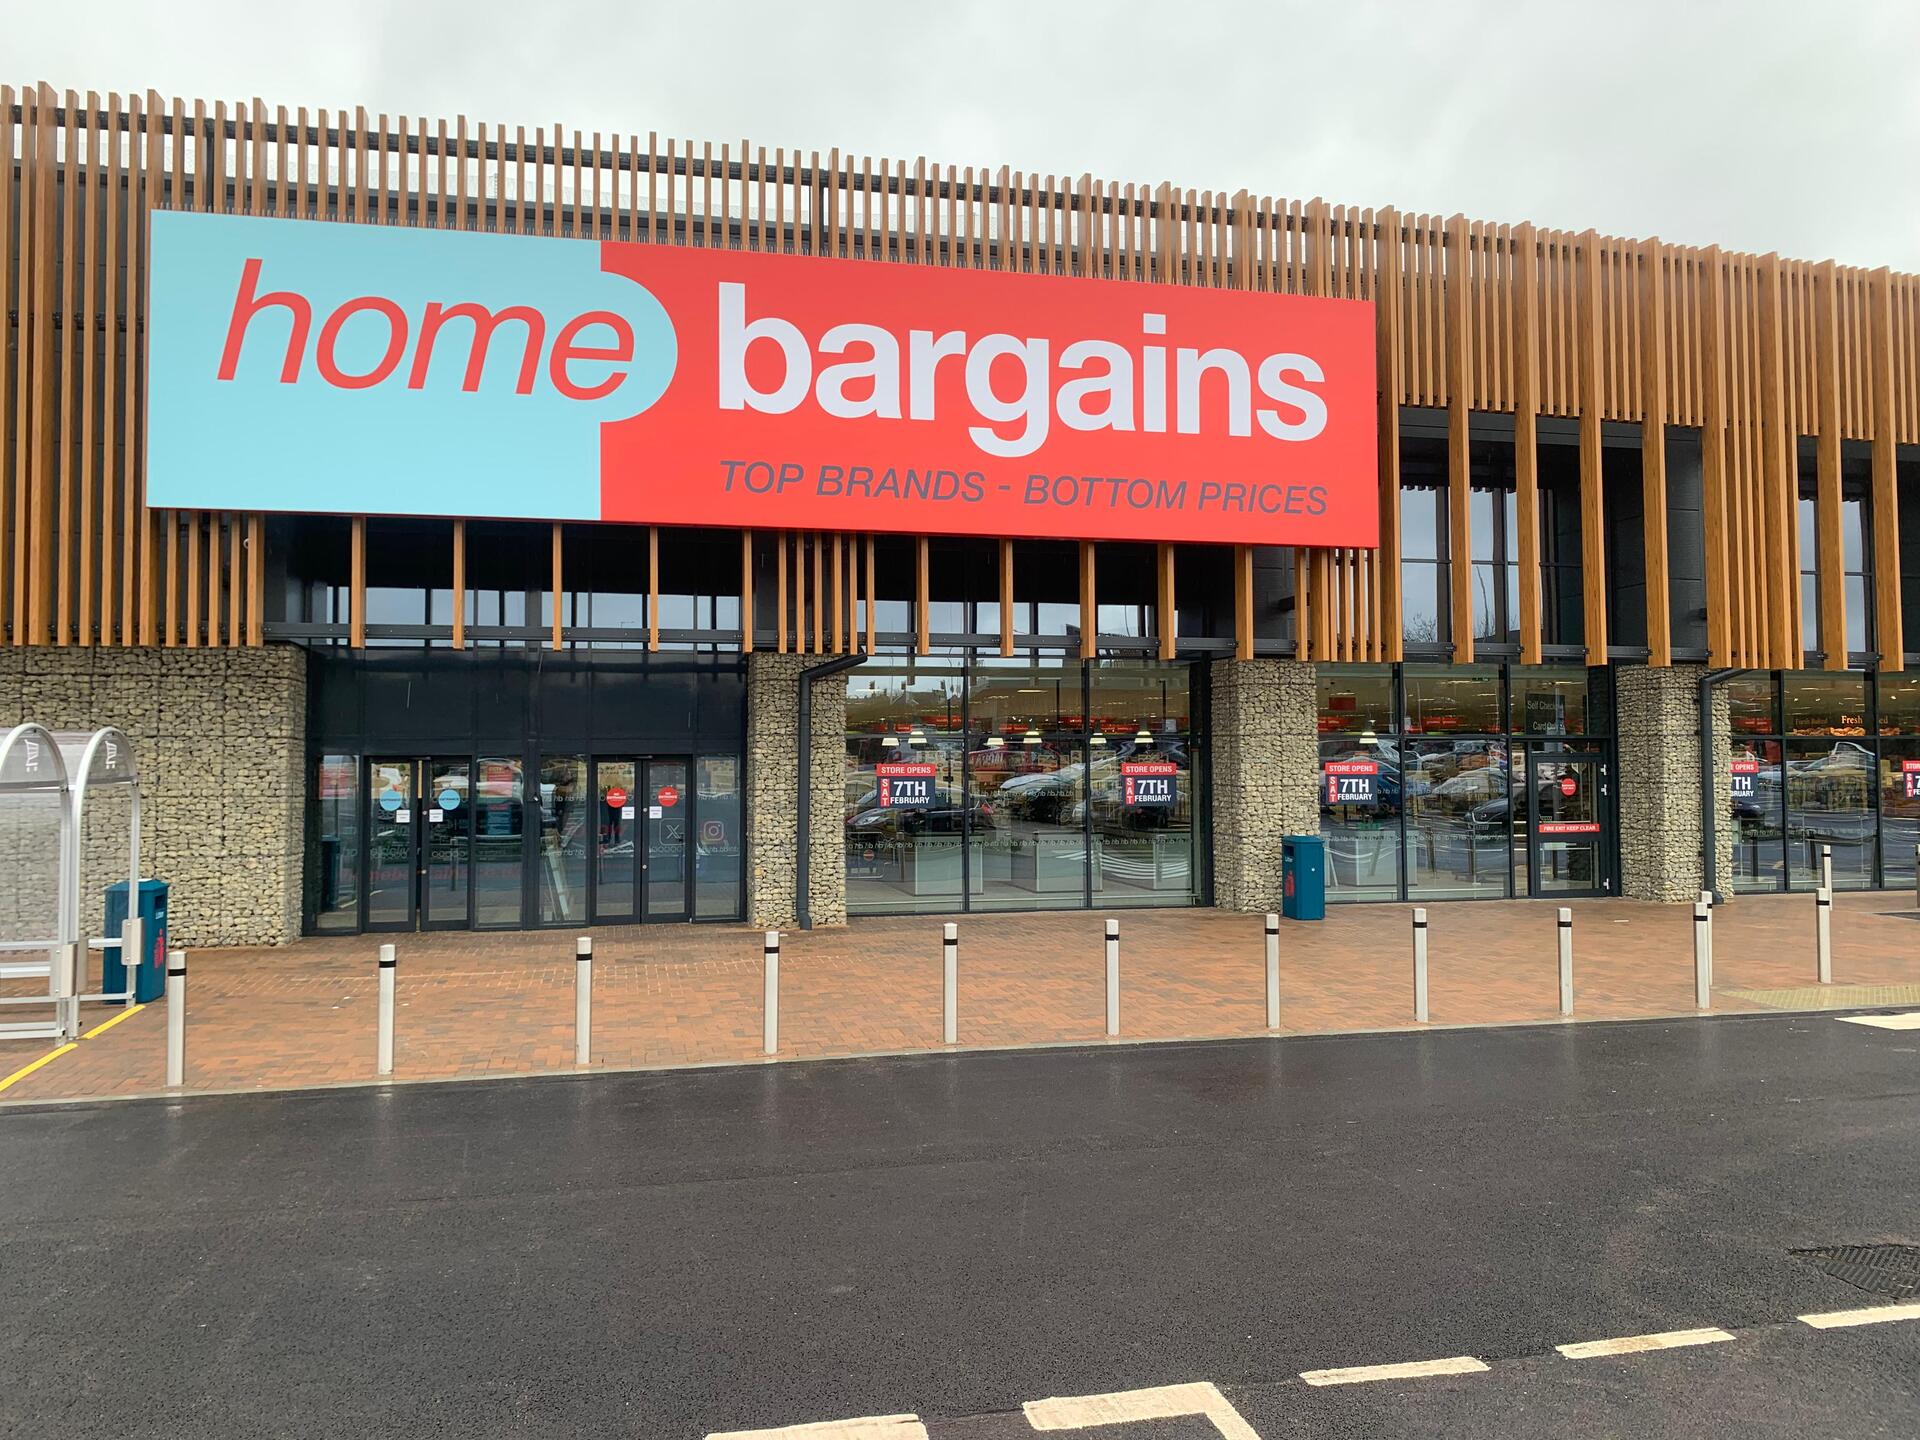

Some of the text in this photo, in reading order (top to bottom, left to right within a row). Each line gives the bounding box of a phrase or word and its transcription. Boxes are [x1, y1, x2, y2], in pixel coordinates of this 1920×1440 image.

[218, 258, 1328, 458] home bargains
[719, 460, 805, 494] TOP
[816, 465, 986, 503] BRANDS
[1023, 474, 1187, 510] BOTTOM
[1198, 481, 1328, 516] PRICES
[1841, 715, 1863, 724] Fresh
[881, 766, 932, 774] STORE OPENS
[1125, 765, 1173, 773] STORE OPENS
[893, 780, 927, 797] 7TH
[1137, 779, 1168, 795] 7TH
[1340, 778, 1369, 793] 7TH
[881, 778, 889, 806] SAT
[1134, 794, 1172, 802] FEBRUARY
[1337, 793, 1373, 801] FEBRUARY
[890, 796, 930, 804] FEBRUARY
